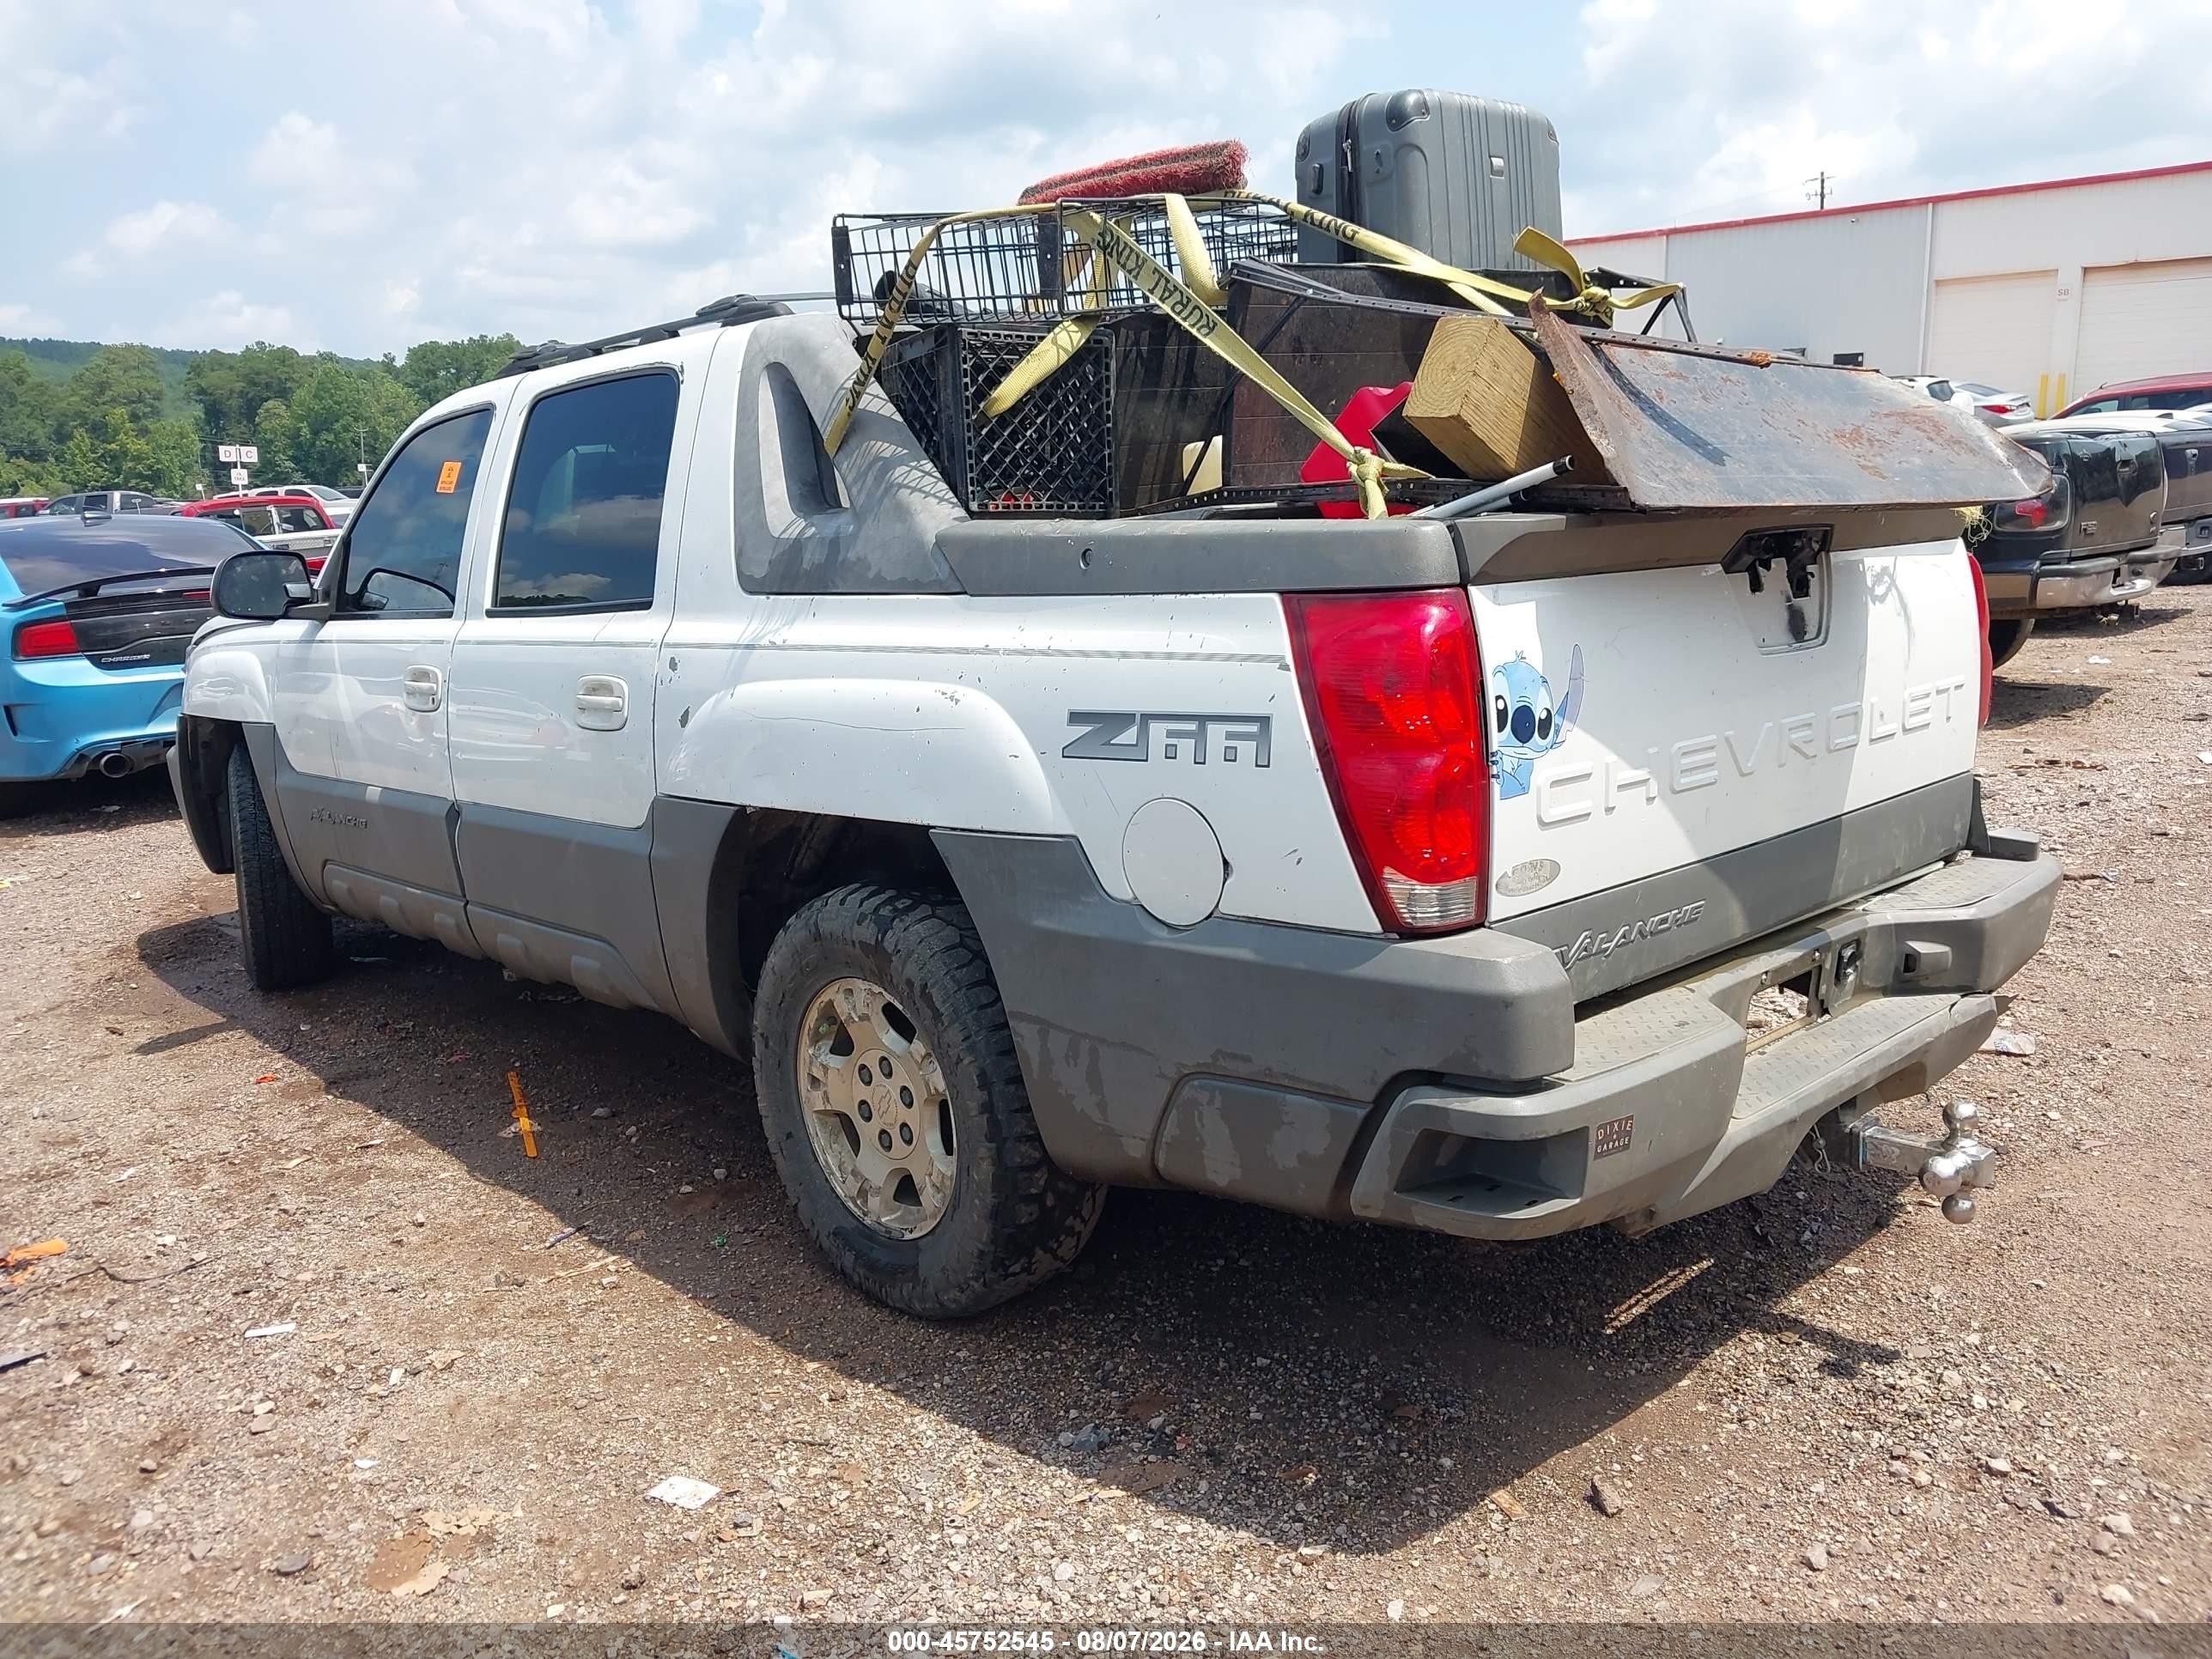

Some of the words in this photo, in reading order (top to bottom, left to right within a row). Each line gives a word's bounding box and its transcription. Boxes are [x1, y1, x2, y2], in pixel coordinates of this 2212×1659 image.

[1304, 209, 1359, 241] KING
[1097, 228, 1147, 282] KING
[1148, 266, 1218, 337] RURAL
[224, 450, 232, 459] D
[246, 450, 253, 459] C
[100, 654, 150, 663] CHARGER
[1536, 674, 1966, 831] CHEVROLET
[1552, 899, 1706, 970] VALANCHE
[1597, 1120, 1632, 1140] DIXIE
[1597, 1136, 1630, 1153] GARAGE
